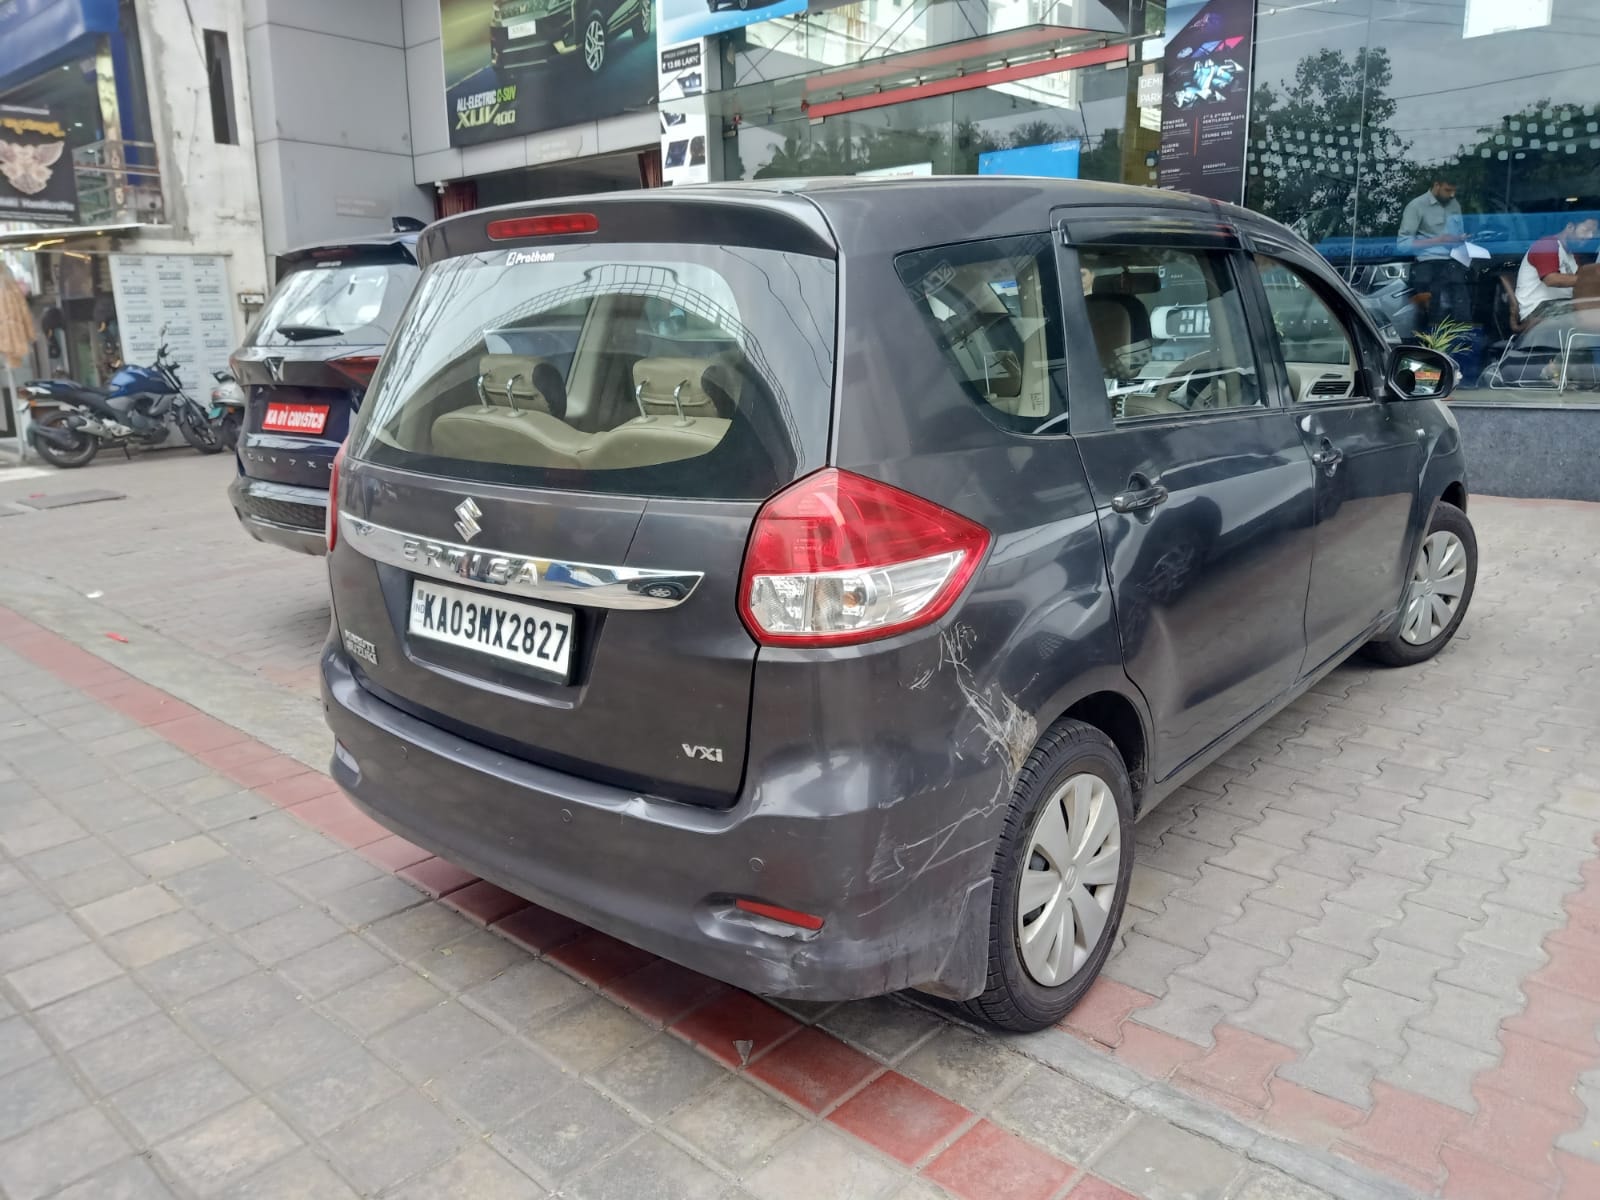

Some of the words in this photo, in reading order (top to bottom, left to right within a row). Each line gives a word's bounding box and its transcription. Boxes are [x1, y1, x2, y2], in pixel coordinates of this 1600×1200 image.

[457, 89, 497, 112] ALL-ELECTRIC
[514, 250, 555, 265] Pratham
[403, 539, 538, 586] ERTIGA
[423, 593, 568, 662] KA03MX2827
[346, 640, 378, 665] SUZUKI
